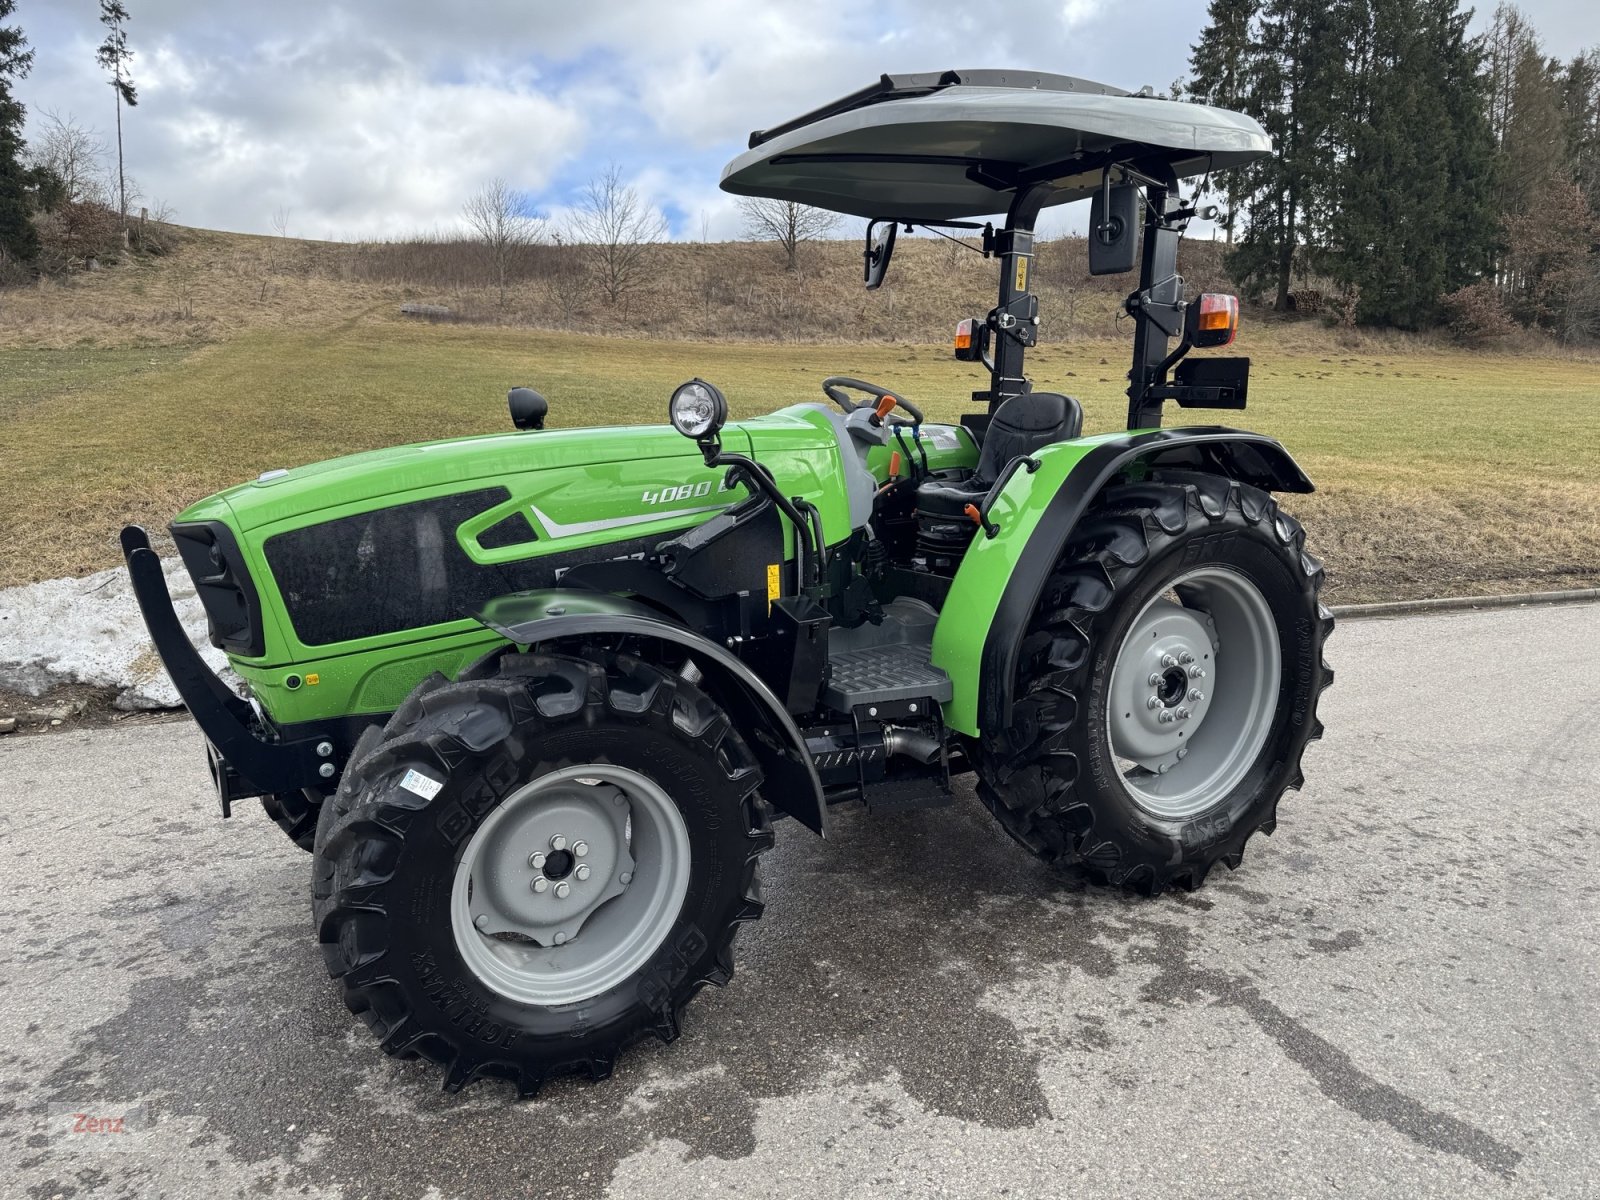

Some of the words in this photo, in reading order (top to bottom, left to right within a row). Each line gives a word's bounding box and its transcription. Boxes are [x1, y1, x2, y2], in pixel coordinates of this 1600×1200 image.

[642, 481, 712, 505] 4080
[437, 753, 519, 847] BKT
[1180, 807, 1232, 852] BKT
